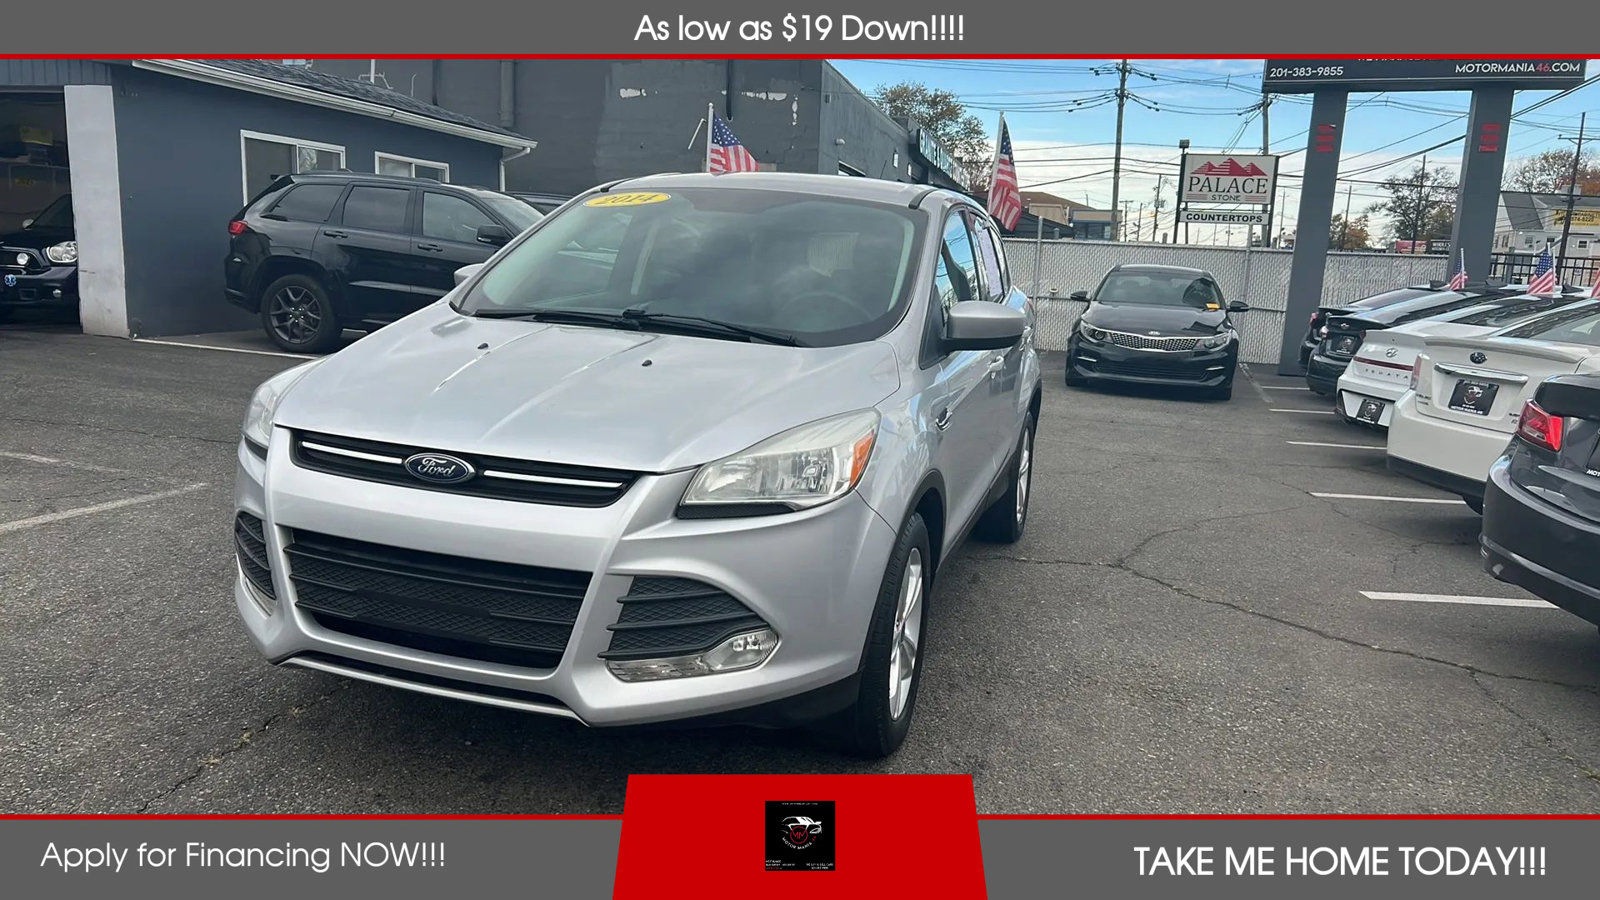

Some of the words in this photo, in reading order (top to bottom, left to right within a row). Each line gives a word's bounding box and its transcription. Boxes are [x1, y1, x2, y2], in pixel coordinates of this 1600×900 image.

[1269, 65, 1344, 78] 201-383-9855
[1454, 61, 1581, 74] MOTORMANIA46.COM
[1187, 176, 1269, 194] PALACE
[594, 193, 659, 205] 2014
[1186, 213, 1263, 223] COUNTERTOPS
[417, 457, 456, 477] Ford
